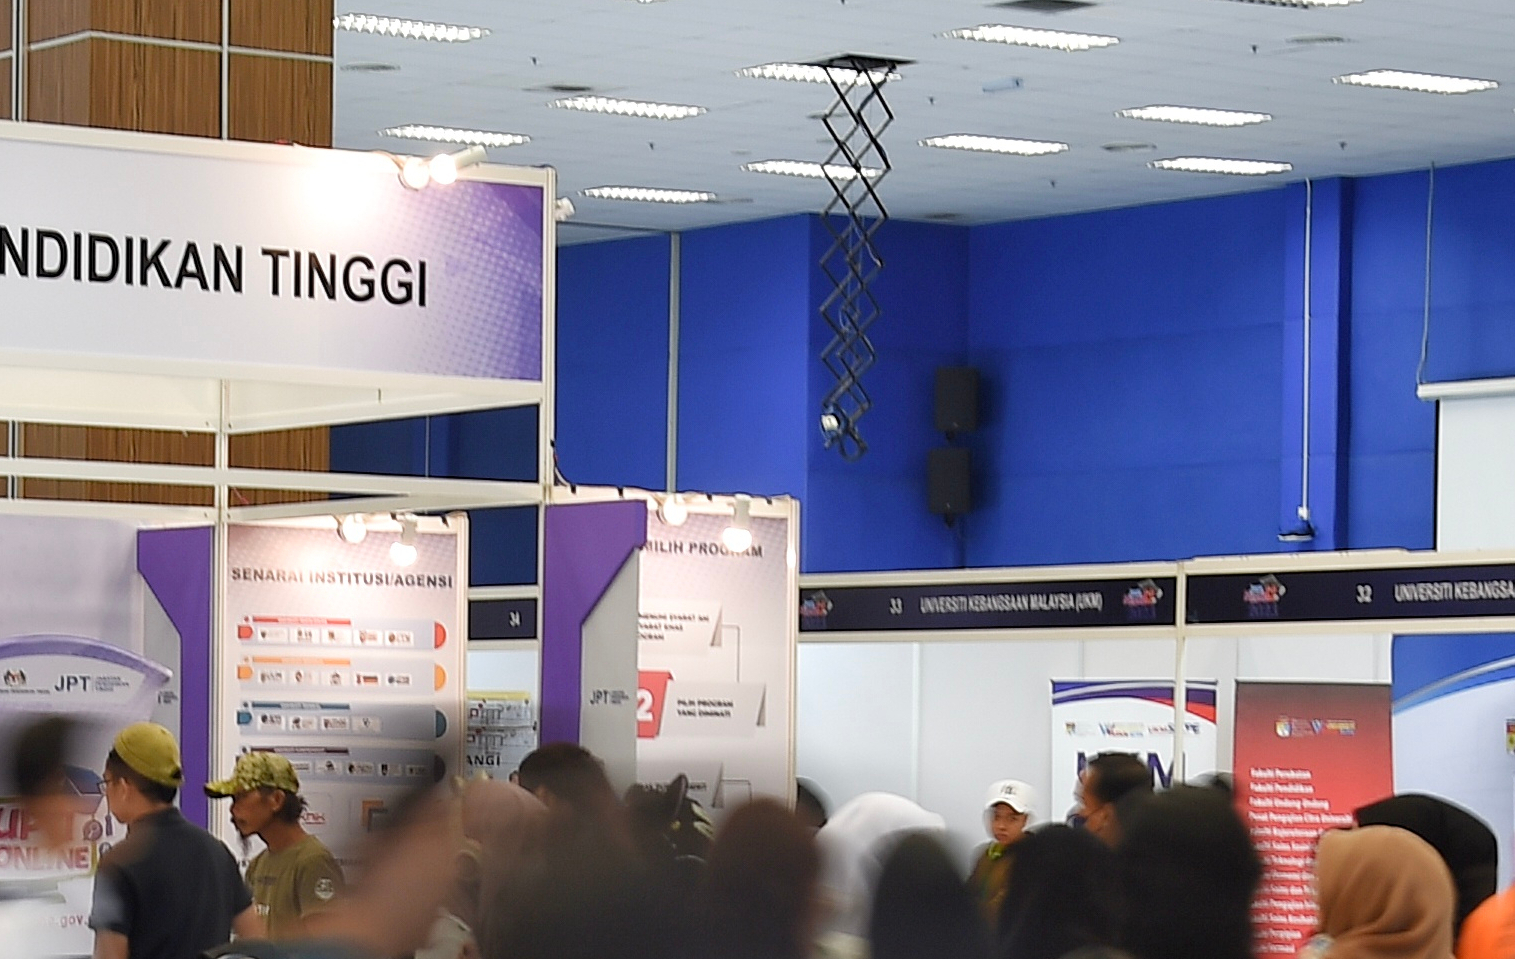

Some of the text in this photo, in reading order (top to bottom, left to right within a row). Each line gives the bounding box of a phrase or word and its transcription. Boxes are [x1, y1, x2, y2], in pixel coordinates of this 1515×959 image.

[260, 246, 430, 308] TINGGI
[231, 566, 453, 588] SENARAI INSTITUSI/AGENSI
[920, 595, 967, 613] UNIVERSITI
[968, 594, 1028, 612] KEBANGSAAN
[1030, 593, 1074, 611] MALAYSIA
[1356, 583, 1373, 603] 32
[1394, 582, 1453, 602] UNIVERSITI
[54, 675, 91, 693] JPT
[638, 687, 654, 722] 2
